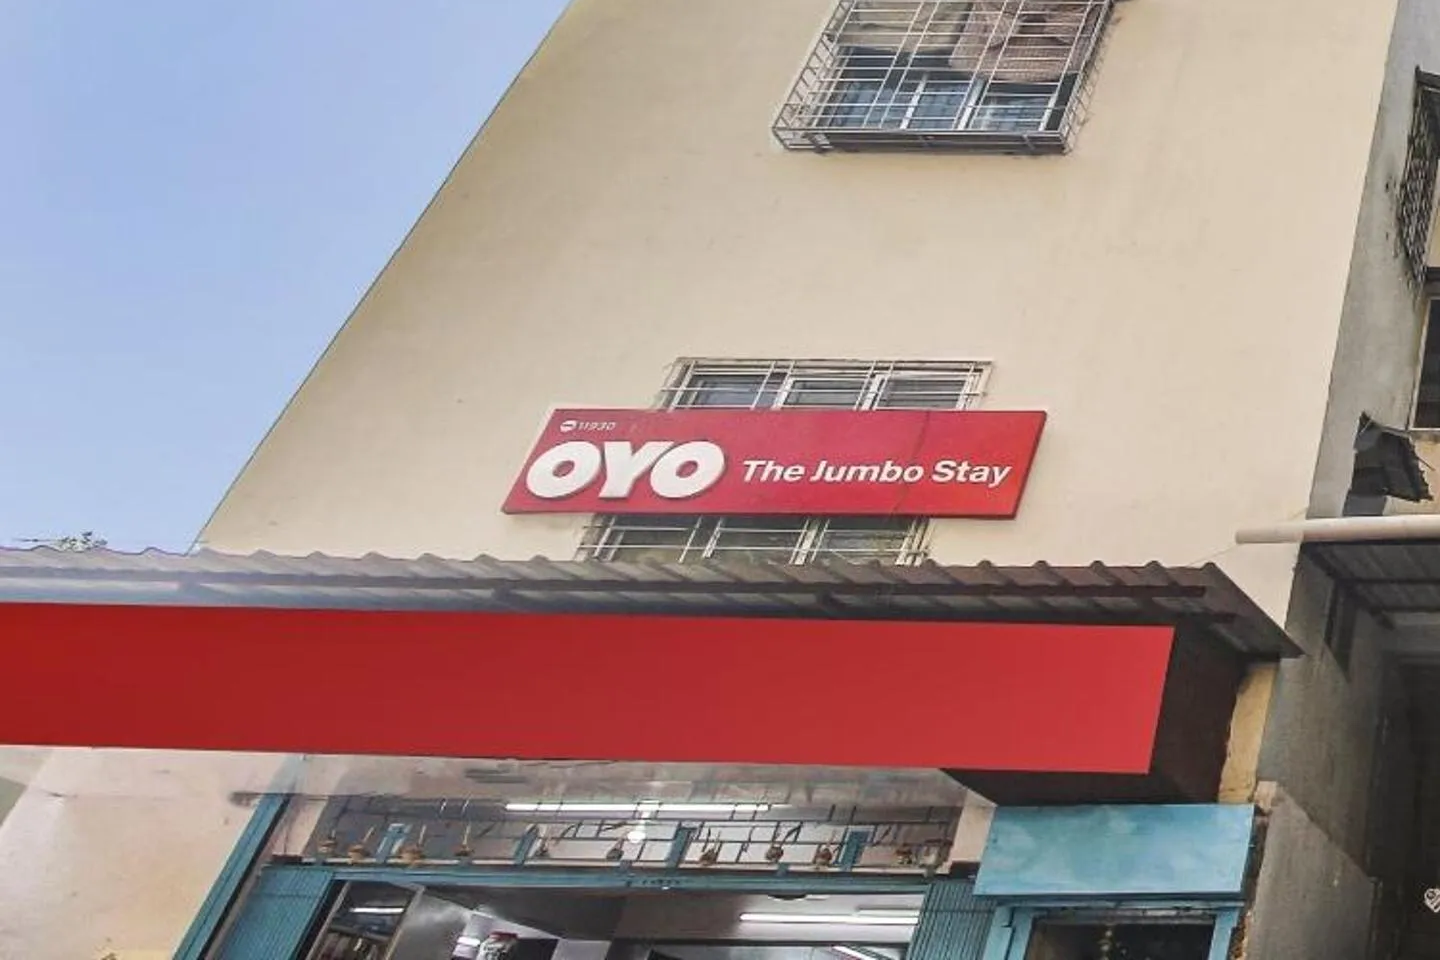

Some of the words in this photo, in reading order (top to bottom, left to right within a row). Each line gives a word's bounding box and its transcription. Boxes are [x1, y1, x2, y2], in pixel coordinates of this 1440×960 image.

[526, 440, 726, 499] OYO
[742, 460, 805, 482] The
[809, 460, 925, 483] Jumbo
[931, 460, 1011, 488] Stay
